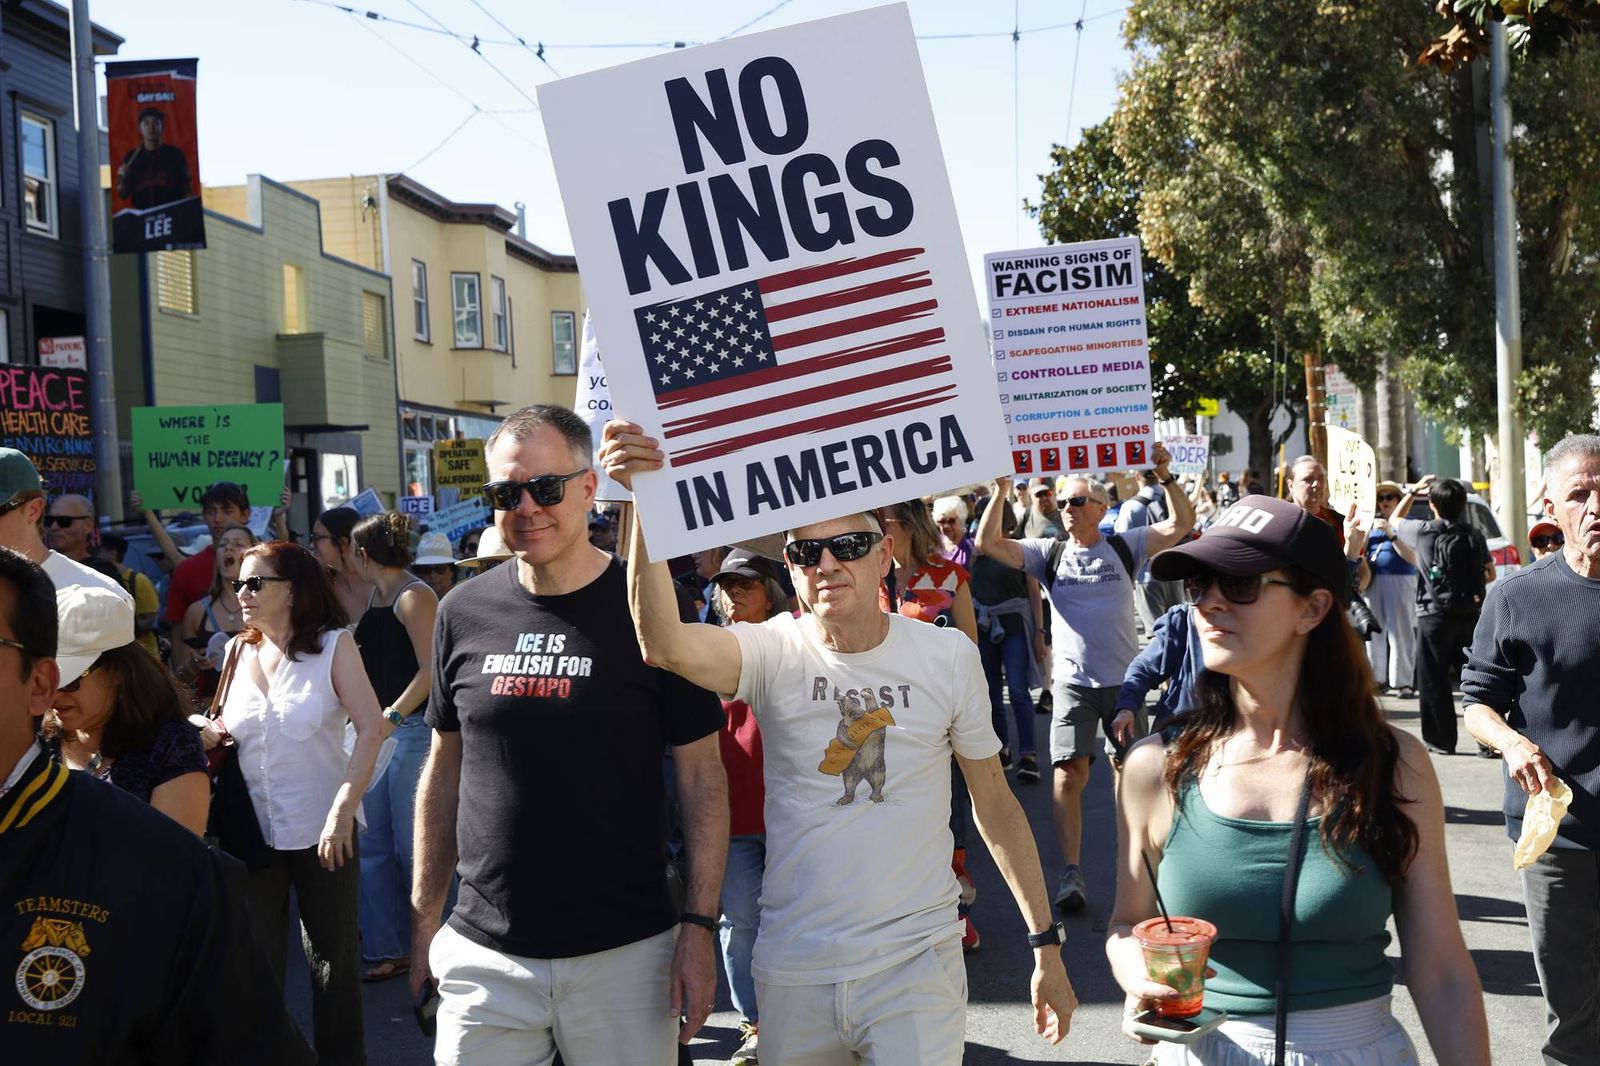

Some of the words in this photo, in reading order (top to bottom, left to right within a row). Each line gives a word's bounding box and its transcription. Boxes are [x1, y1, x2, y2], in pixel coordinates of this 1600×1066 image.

[664, 56, 809, 175] NO
[607, 138, 914, 296] KINGS
[145, 217, 172, 240] LEE
[992, 255, 1060, 272] WARNING
[1064, 251, 1109, 266] SIGNS
[1114, 249, 1132, 260] OF
[995, 262, 1133, 298] FACISIM
[1006, 303, 1059, 317] EXTREME
[1062, 296, 1139, 312] NATIONALISM
[1007, 327, 1045, 338] DISDAIN
[1048, 325, 1067, 334] FOR
[1069, 321, 1104, 332] HUMAN
[1106, 318, 1142, 329] RIGHTS
[1009, 343, 1083, 358] SCAPEGOATING
[1086, 339, 1143, 351] MINORITIES
[1011, 364, 1099, 381] CONTROLLED
[1102, 360, 1144, 373] MEDIA
[0, 369, 85, 411] PEACE
[1013, 388, 1089, 402] MILITARIZATION
[1091, 387, 1104, 396] OF
[1106, 383, 1147, 394] SOCIETY
[1, 409, 48, 436] HEALTH
[51, 412, 90, 437] CARE
[160, 416, 205, 429] WHERE
[213, 408, 231, 428] IS
[1015, 409, 1081, 422] CORRUPTION
[1083, 407, 1091, 416] &
[1094, 404, 1148, 416] CRONYISM
[184, 435, 210, 445] THE
[1017, 431, 1069, 445] RIGGED
[1072, 424, 1150, 440] ELECTIONS
[46, 456, 96, 472] SERVICES
[149, 451, 201, 468] HUMAN
[439, 449, 479, 458] OPERATION
[439, 474, 484, 484] CALIFORNIA!
[675, 470, 735, 531] IN
[746, 414, 975, 516] AMERICA
[402, 500, 429, 512] ICE
[515, 633, 545, 653] ICE
[546, 634, 566, 653] IS
[481, 654, 554, 675] ENGLISH
[556, 656, 593, 677] FOR
[491, 676, 571, 698] GESTAPO
[14, 896, 110, 923] TEAMSTERS
[8, 1010, 55, 1025] LOCAL
